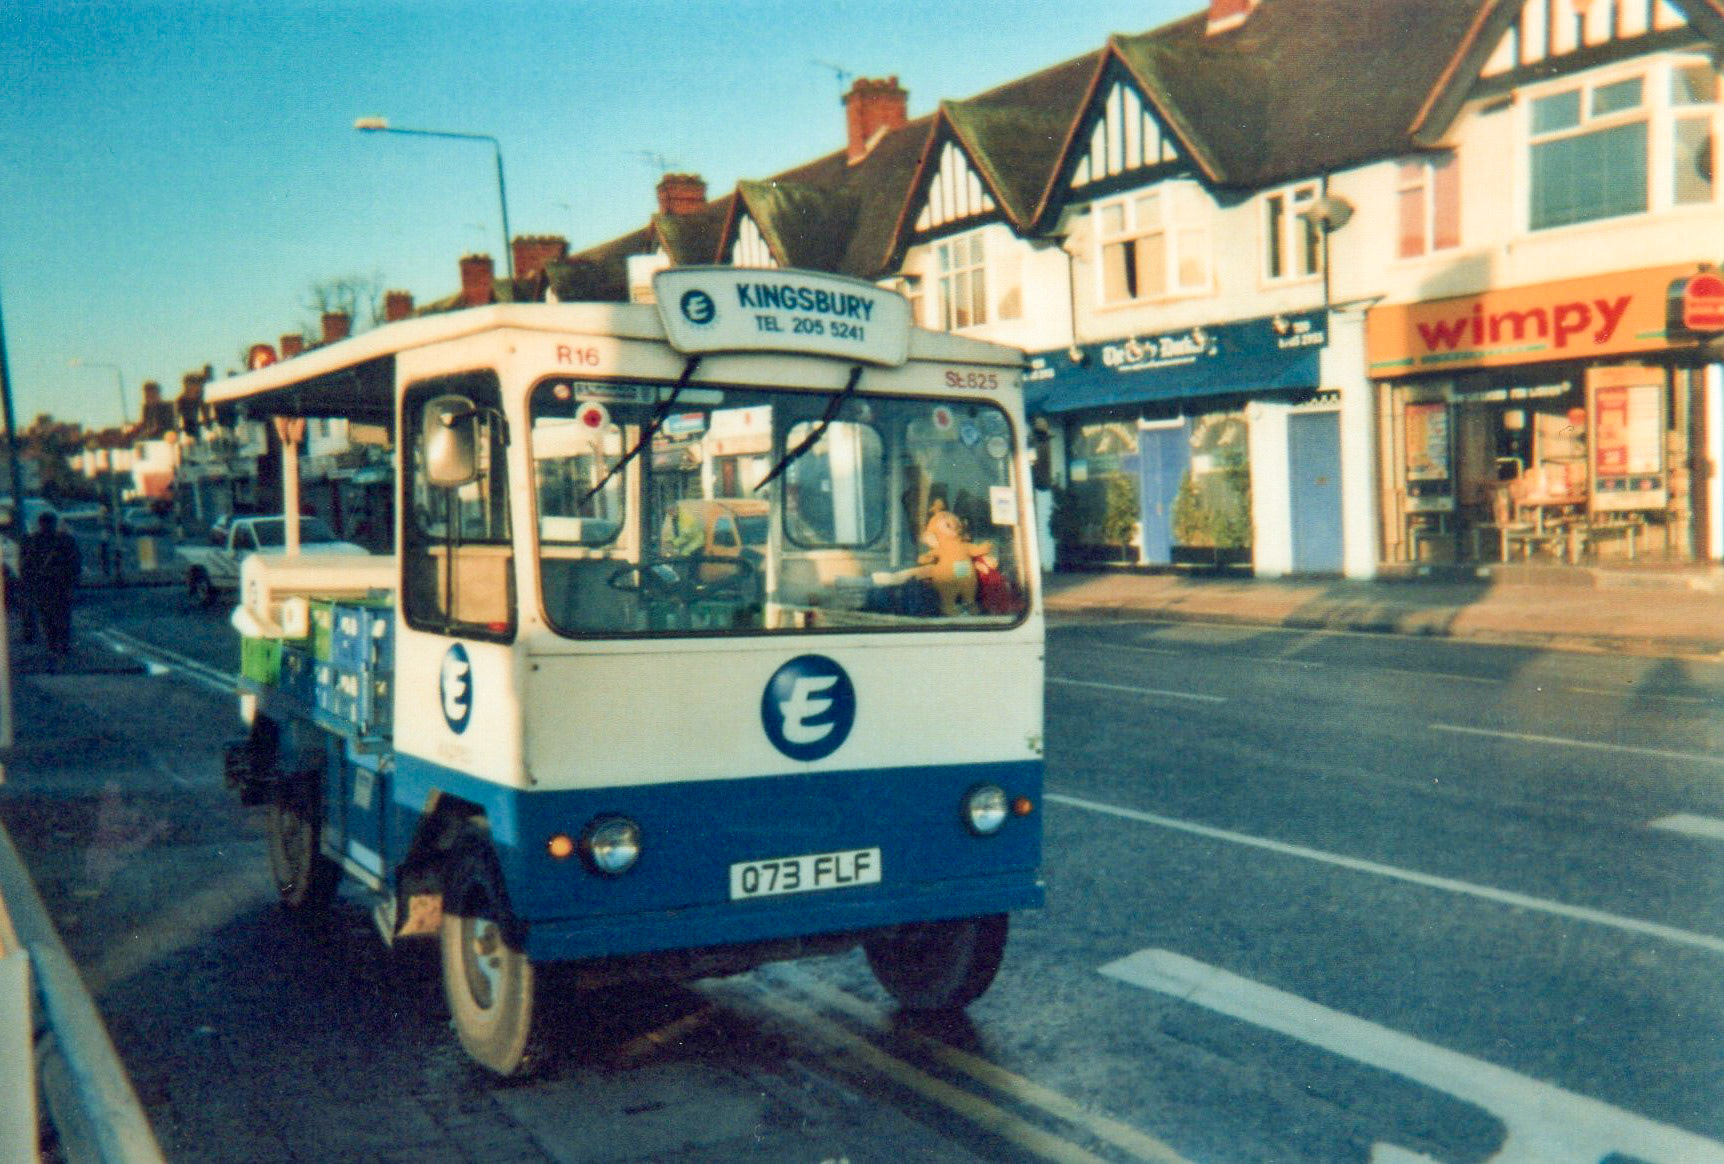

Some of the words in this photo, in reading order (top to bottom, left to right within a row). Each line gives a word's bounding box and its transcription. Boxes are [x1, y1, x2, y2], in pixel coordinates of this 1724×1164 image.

[736, 283, 875, 321] KINGSBURY
[792, 317, 825, 334] 205
[830, 321, 865, 341] 5241
[1416, 296, 1632, 351] wimpy
[557, 344, 600, 366] R16
[742, 860, 801, 893] Q73
[814, 852, 870, 886] FLF
